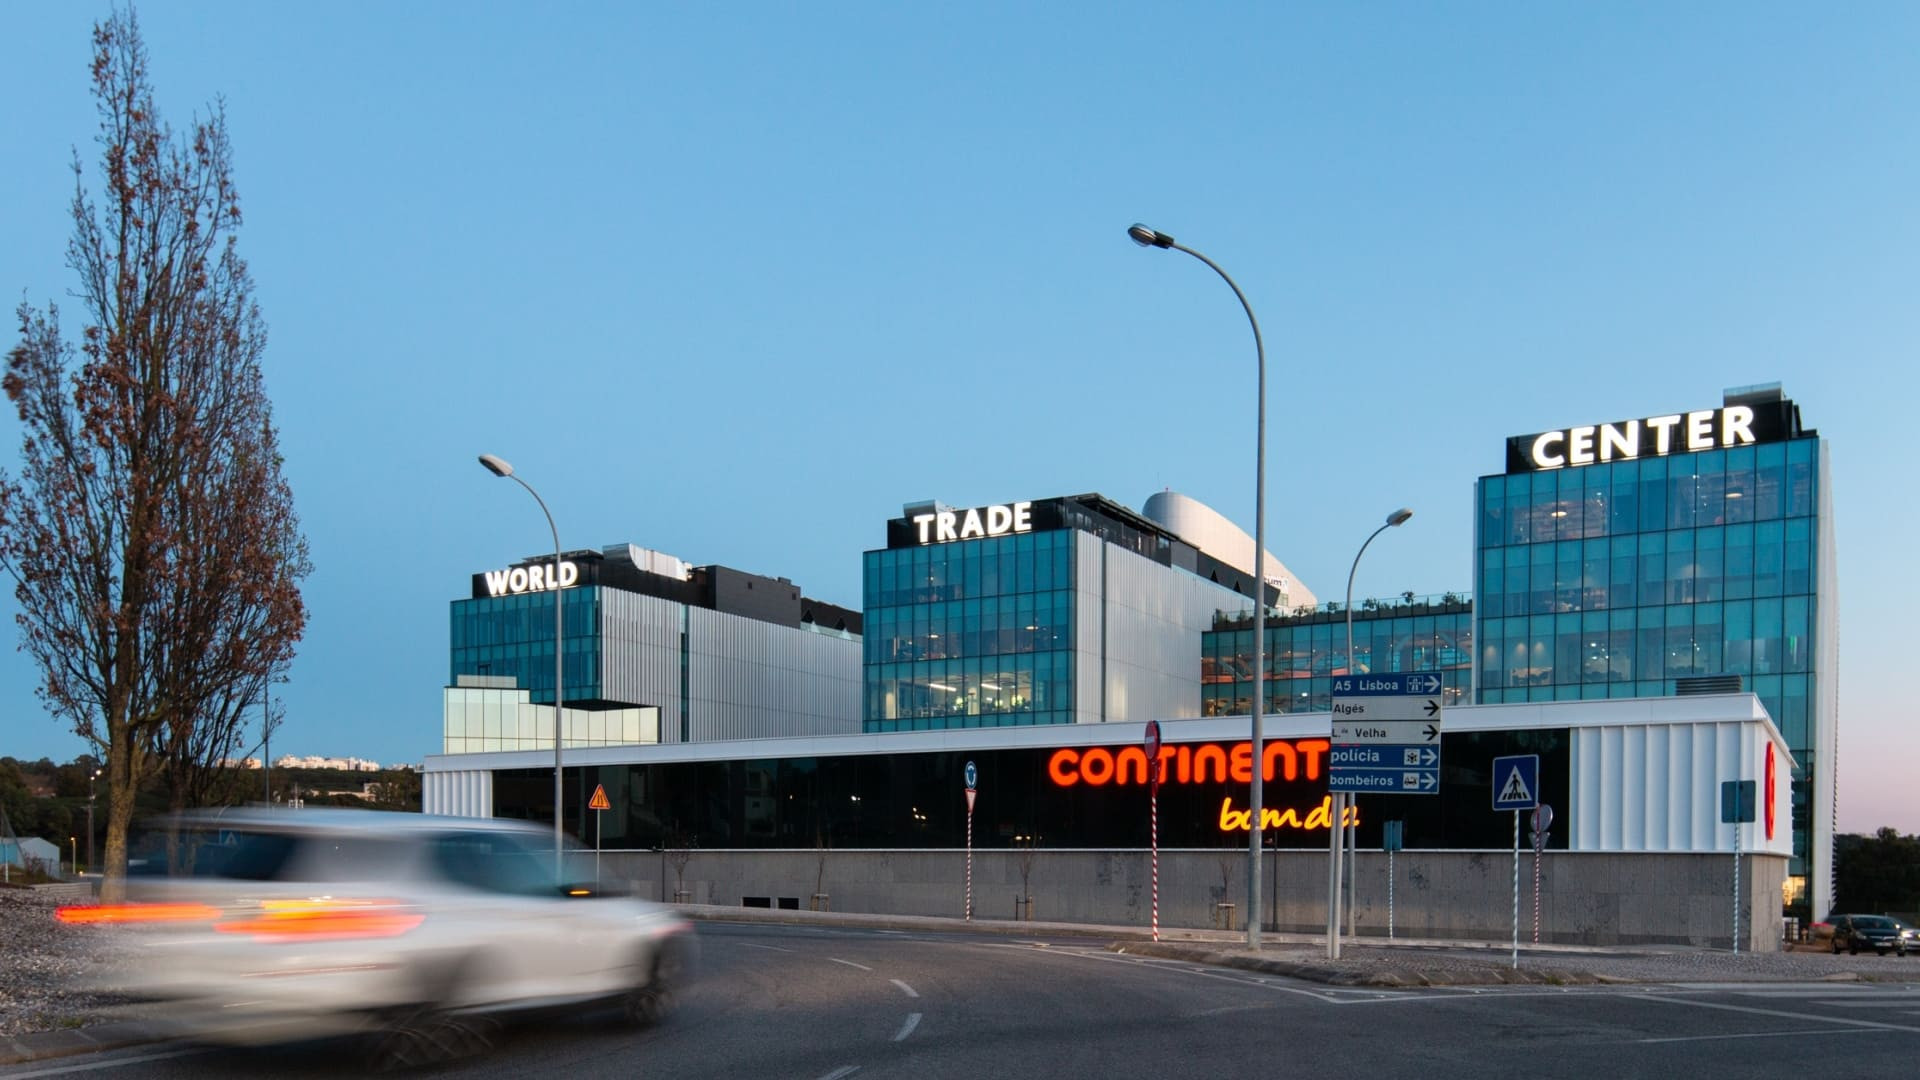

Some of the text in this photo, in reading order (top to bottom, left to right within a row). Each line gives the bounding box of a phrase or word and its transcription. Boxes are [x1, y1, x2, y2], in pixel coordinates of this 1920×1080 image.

[1531, 405, 1756, 470] CENTER
[913, 501, 1032, 544] TRADE
[485, 560, 578, 597] WORLD
[1334, 679, 1399, 691] A5 Lisboa
[1333, 703, 1365, 715] Algés
[1355, 727, 1387, 738] Velha
[1330, 748, 1380, 763] polícia
[1330, 773, 1394, 786] bombeiros
